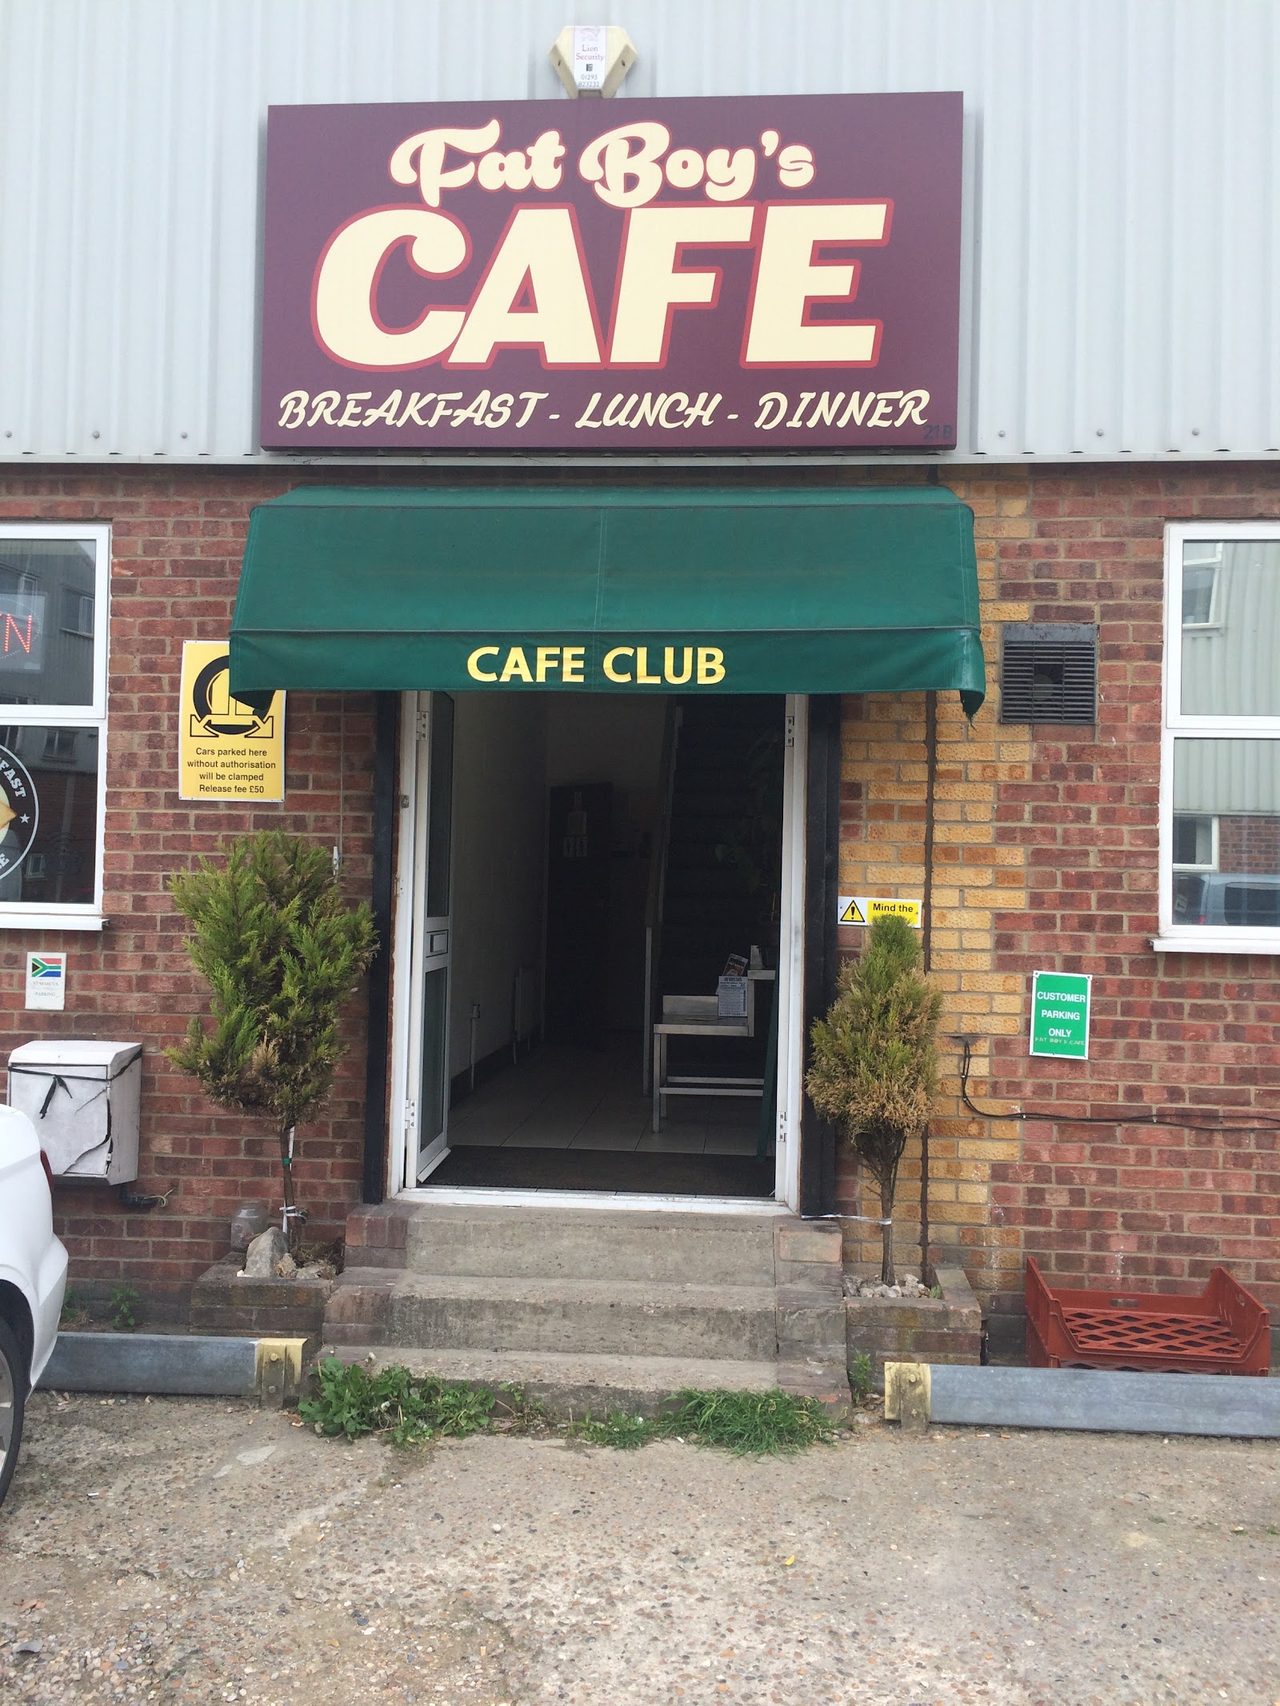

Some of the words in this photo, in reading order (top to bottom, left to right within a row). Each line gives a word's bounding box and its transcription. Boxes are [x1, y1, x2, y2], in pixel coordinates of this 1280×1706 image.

[576, 53, 604, 62] Security
[389, 118, 566, 208] Fat
[578, 121, 815, 209] Boy's
[313, 201, 890, 369] CAFE
[278, 389, 549, 429] BREAKFAST
[575, 391, 722, 428] LUNCH
[754, 389, 931, 430] DINNER
[466, 646, 586, 683] CAFE
[602, 646, 726, 685] CLUB
[195, 747, 216, 756] Cars
[217, 748, 247, 759] parked
[248, 748, 268, 757] here
[187, 759, 218, 768] without
[220, 760, 276, 769] authorisation
[199, 772, 214, 780] will
[228, 773, 264, 782] clamped
[199, 784, 232, 793] Release
[234, 785, 247, 793] fee
[249, 785, 265, 794] £50
[873, 903, 896, 912] Mind
[898, 904, 913, 913] the
[1037, 991, 1086, 1003] CUSTOMER
[1041, 1009, 1080, 1020] PARKING
[1048, 1027, 1072, 1038] ONLY
